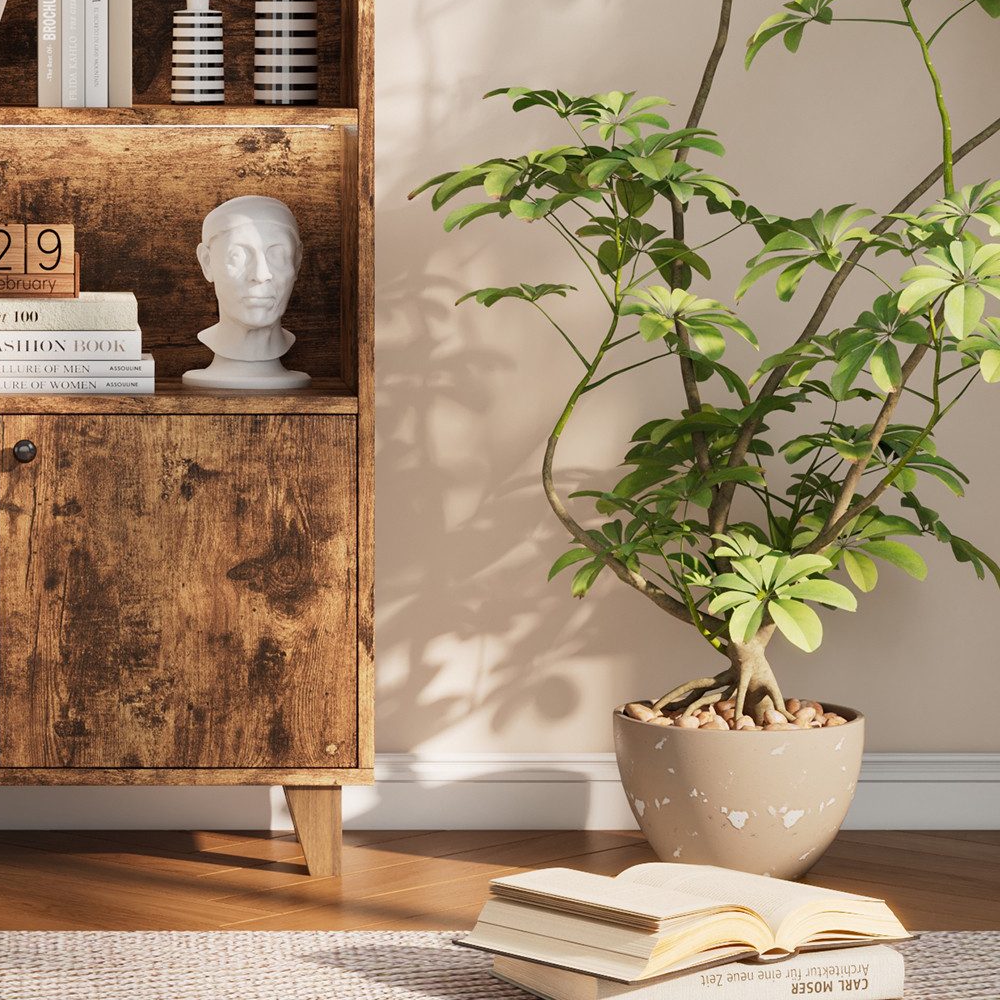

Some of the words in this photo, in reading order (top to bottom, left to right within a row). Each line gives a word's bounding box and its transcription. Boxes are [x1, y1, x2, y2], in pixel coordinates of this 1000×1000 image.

[68, 36, 78, 69] KAHLO
[68, 72, 78, 101] FRIDA
[14, 311, 39, 322] 100
[74, 340, 126, 352] BOOK
[44, 365, 60, 373] OF
[63, 365, 90, 373] MEN
[30, 381, 47, 390] OF
[50, 381, 97, 390] WOMEN
[758, 969, 782, 980] eine
[786, 968, 802, 982] für
[805, 963, 869, 977] Architektur
[701, 974, 723, 987] Zeit
[726, 972, 754, 982] neue
[791, 980, 833, 995] MOSER
[841, 978, 868, 991] CARL
